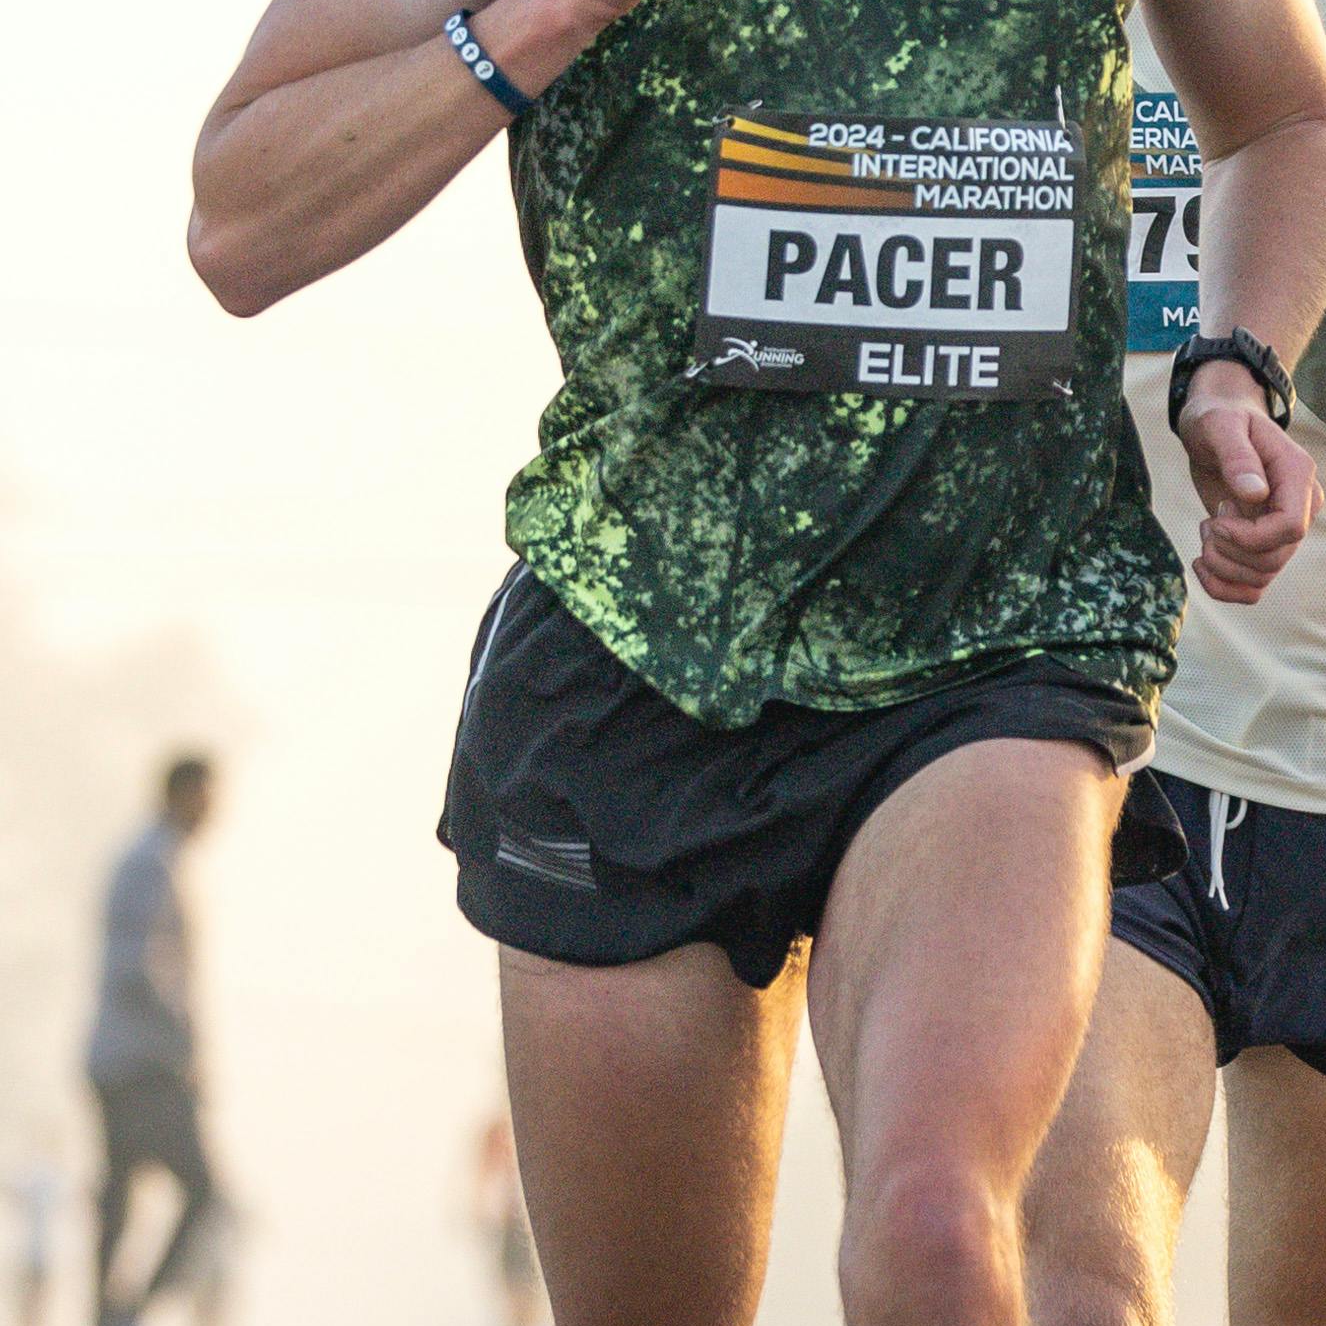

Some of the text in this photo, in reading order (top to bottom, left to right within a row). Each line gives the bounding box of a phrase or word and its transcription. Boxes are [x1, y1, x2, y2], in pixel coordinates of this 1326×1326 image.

[1136, 100, 1188, 123] CAL
[808, 123, 886, 149] 2024
[911, 127, 1074, 153] CALIFORNIA
[1130, 127, 1199, 150] ERNA
[851, 153, 1074, 181] INTERNATIONAL
[1145, 154, 1203, 175] MAR
[913, 185, 1074, 210] MARATHON
[764, 228, 1025, 312] PACER
[1163, 306, 1201, 327] MA
[857, 341, 1001, 388] ELITE
